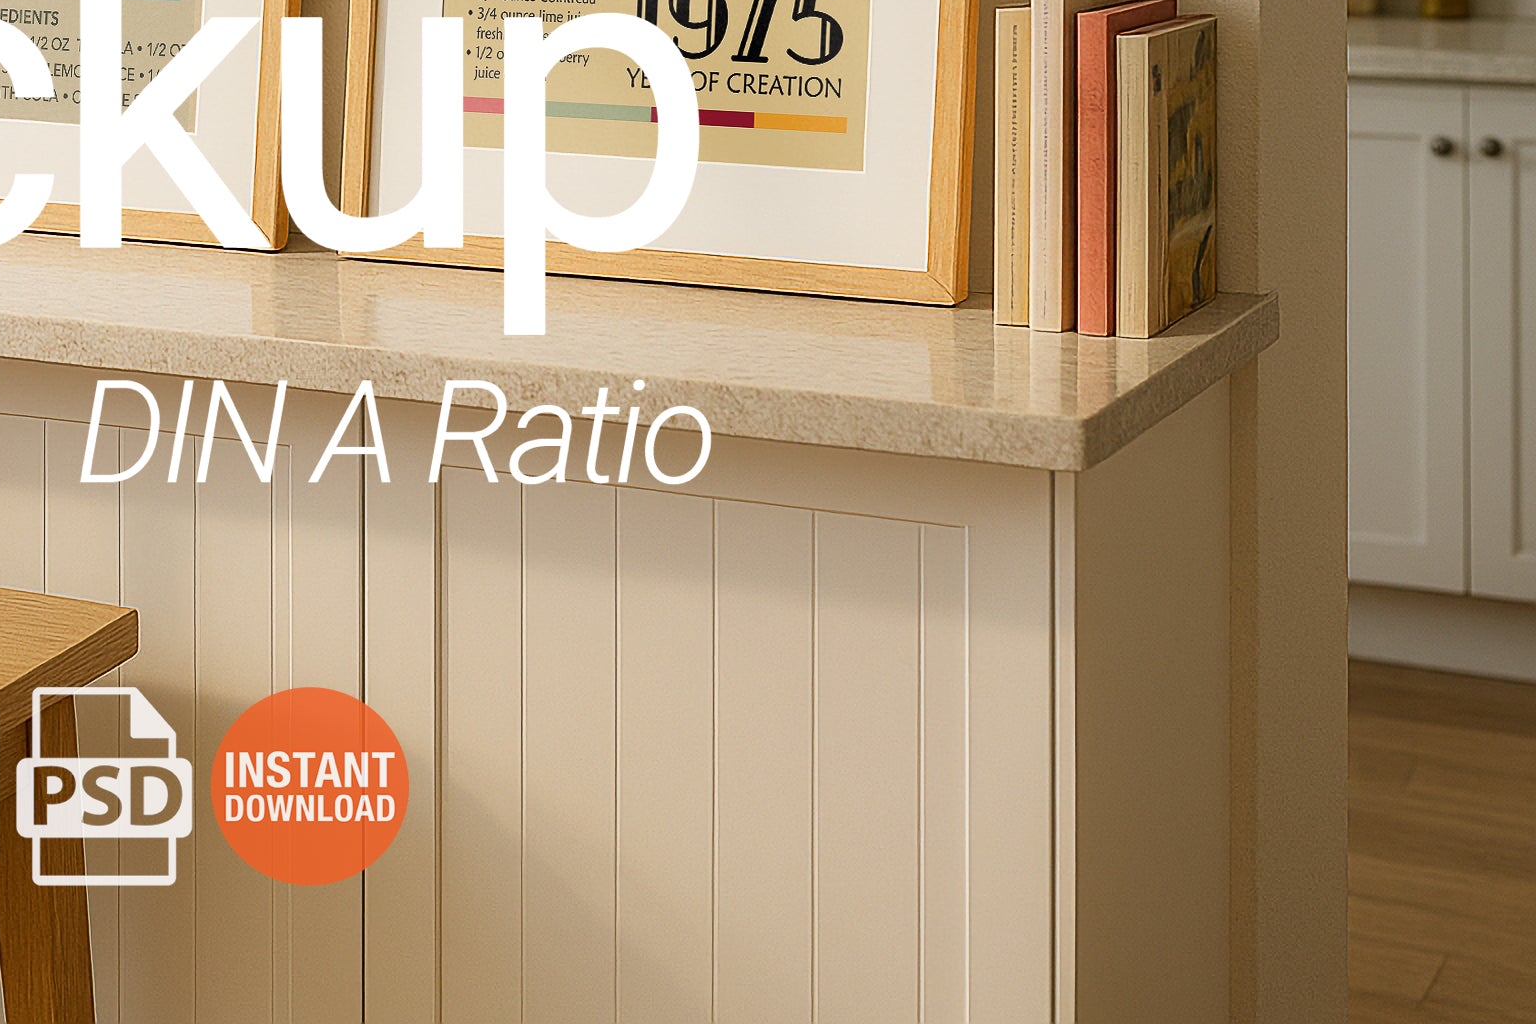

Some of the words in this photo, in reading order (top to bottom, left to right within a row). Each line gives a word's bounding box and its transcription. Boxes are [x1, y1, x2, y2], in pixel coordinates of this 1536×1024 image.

[476, 6, 497, 21] 3/4
[51, 36, 70, 52] OZ
[147, 42, 166, 57] 1/2
[475, 45, 493, 60] 1/2
[473, 65, 501, 81] juice
[690, 70, 720, 92] OF
[726, 72, 843, 98] CREATION
